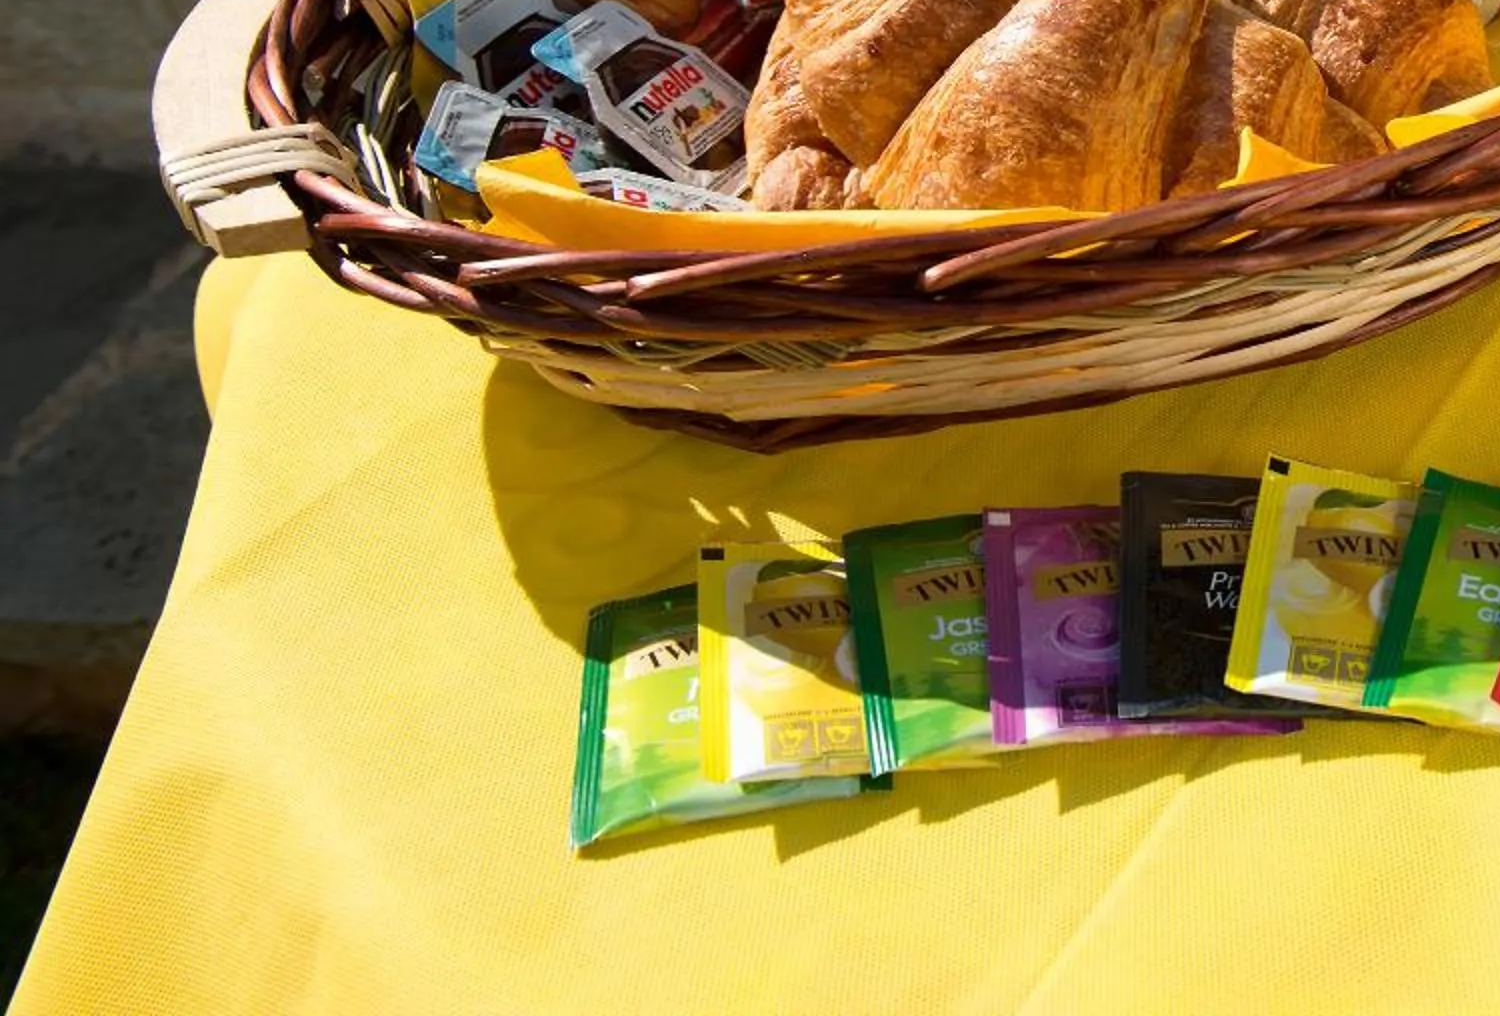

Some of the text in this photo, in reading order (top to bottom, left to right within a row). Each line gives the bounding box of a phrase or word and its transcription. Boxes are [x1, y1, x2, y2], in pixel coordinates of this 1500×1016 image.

[629, 61, 706, 125] nutella
[1173, 533, 1250, 563] TWI
[1307, 533, 1402, 558] TWIN
[907, 567, 986, 602] TWI
